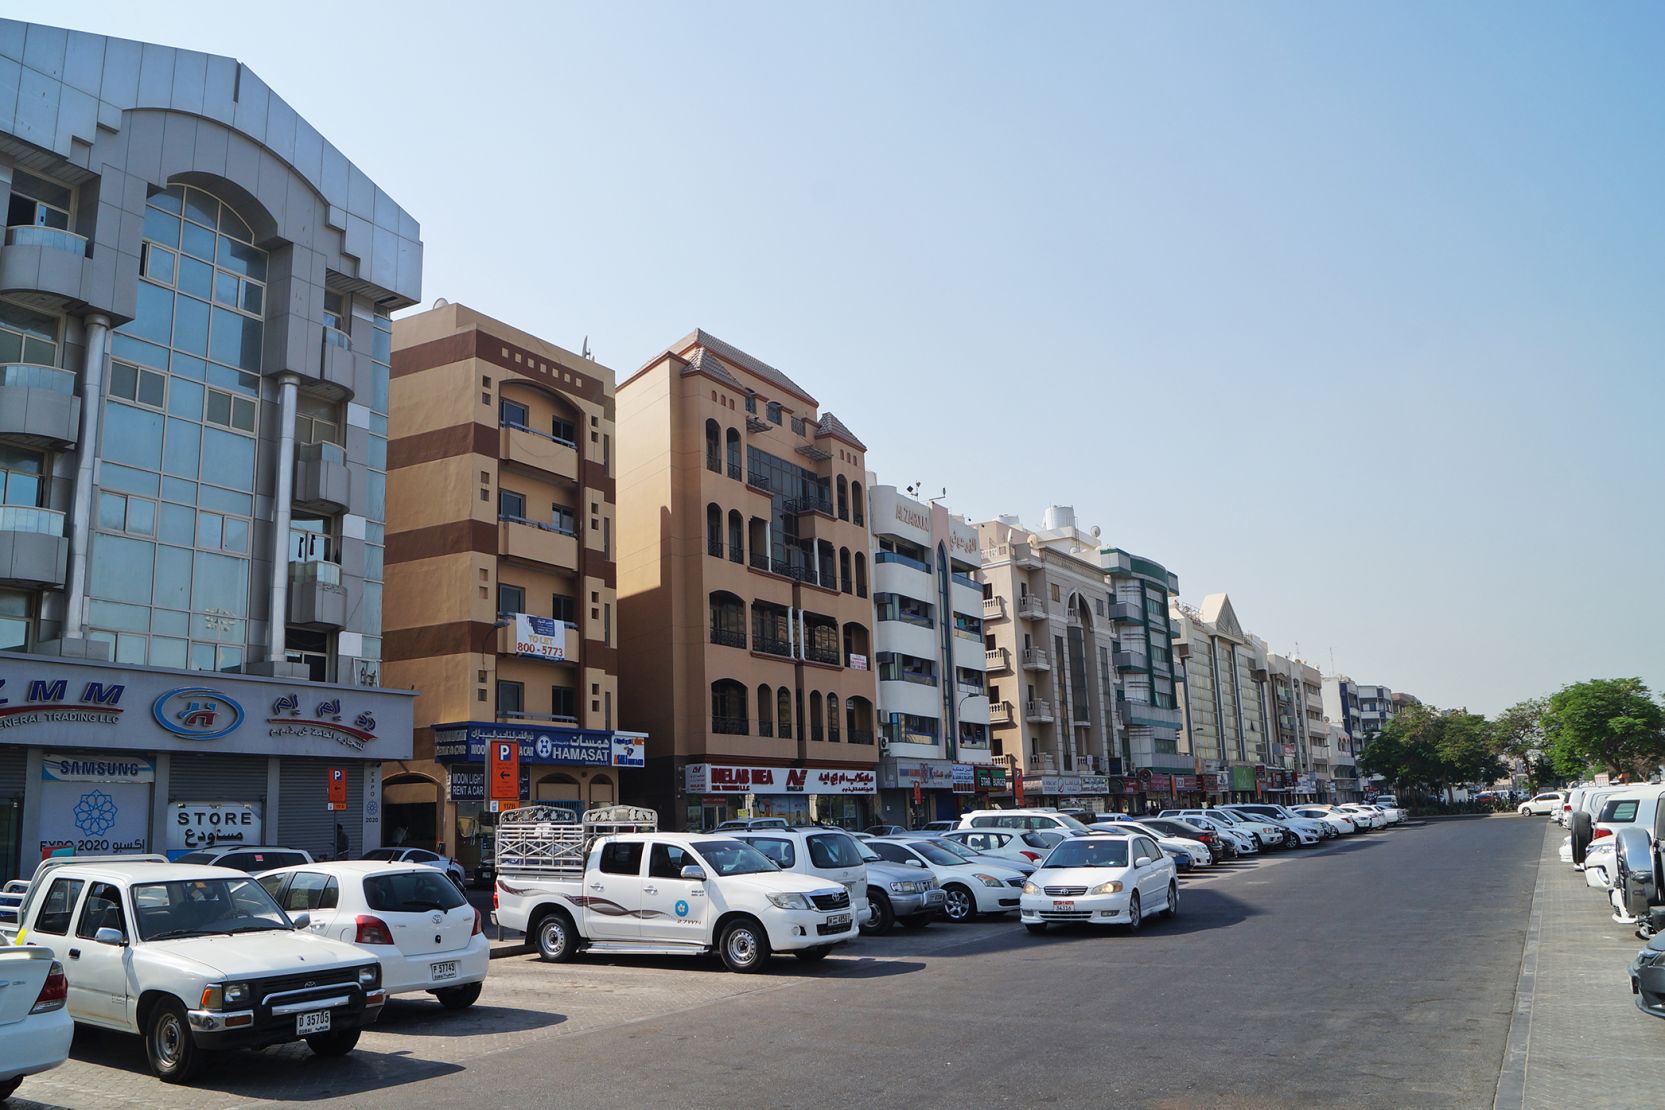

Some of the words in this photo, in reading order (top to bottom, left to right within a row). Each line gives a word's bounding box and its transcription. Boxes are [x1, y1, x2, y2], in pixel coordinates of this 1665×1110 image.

[528, 634, 539, 644] TO
[540, 636, 554, 647] LET
[517, 641, 536, 653] 800
[541, 645, 564, 657] 5773
[0, 715, 42, 729] ENERAL
[46, 712, 97, 722] TRADING
[99, 714, 120, 725] LLC
[471, 744, 486, 755] MOO
[500, 744, 510, 760] P
[552, 746, 610, 762] HAMASAT
[60, 760, 139, 777] SAMSUNG
[334, 770, 341, 780] P
[452, 785, 467, 796] RENT
[467, 786, 472, 796] A
[472, 785, 484, 796] CAR
[177, 812, 252, 825] STORE
[184, 828, 244, 847] مستودع
[77, 839, 110, 852] 2020
[306, 1012, 329, 1026] 35705
